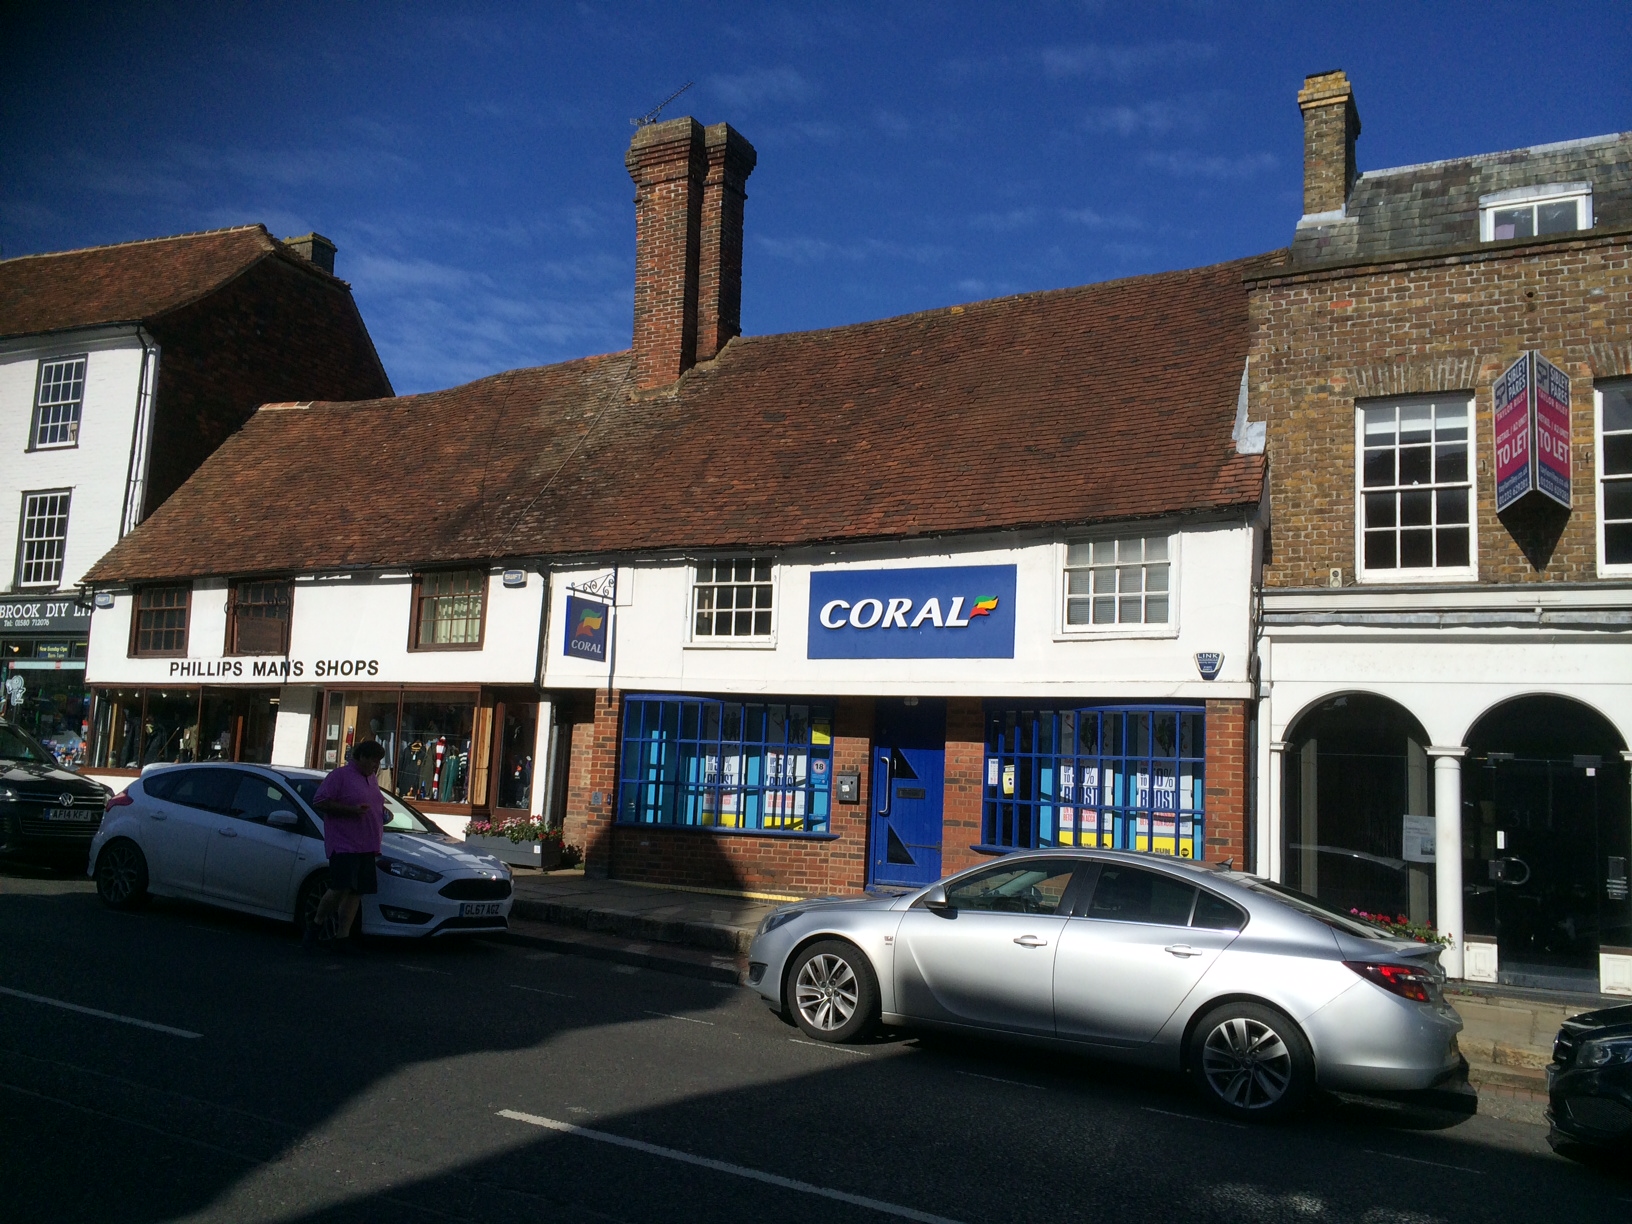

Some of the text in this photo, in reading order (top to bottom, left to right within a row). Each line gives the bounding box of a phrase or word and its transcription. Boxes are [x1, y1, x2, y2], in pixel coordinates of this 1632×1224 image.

[1507, 358, 1525, 386] SIBLEY
[1550, 366, 1567, 391] SIBLEY
[1508, 373, 1525, 400] PARES
[1550, 381, 1567, 405] PARES
[1497, 427, 1527, 468] TO LET
[1538, 426, 1568, 465] TO LET
[0, 603, 41, 618] BROOK
[46, 603, 69, 617] DIY
[819, 597, 970, 628] CORAL
[15, 619, 30, 627] 01580
[571, 639, 602, 653] CORAL
[169, 659, 379, 676] PHILLIPS MAN'S SHOPS
[707, 774, 733, 790] BOST
[769, 776, 797, 793] BOST
[1064, 786, 1098, 805] BOST
[1141, 790, 1176, 808] BOST
[465, 904, 486, 915] GL67
